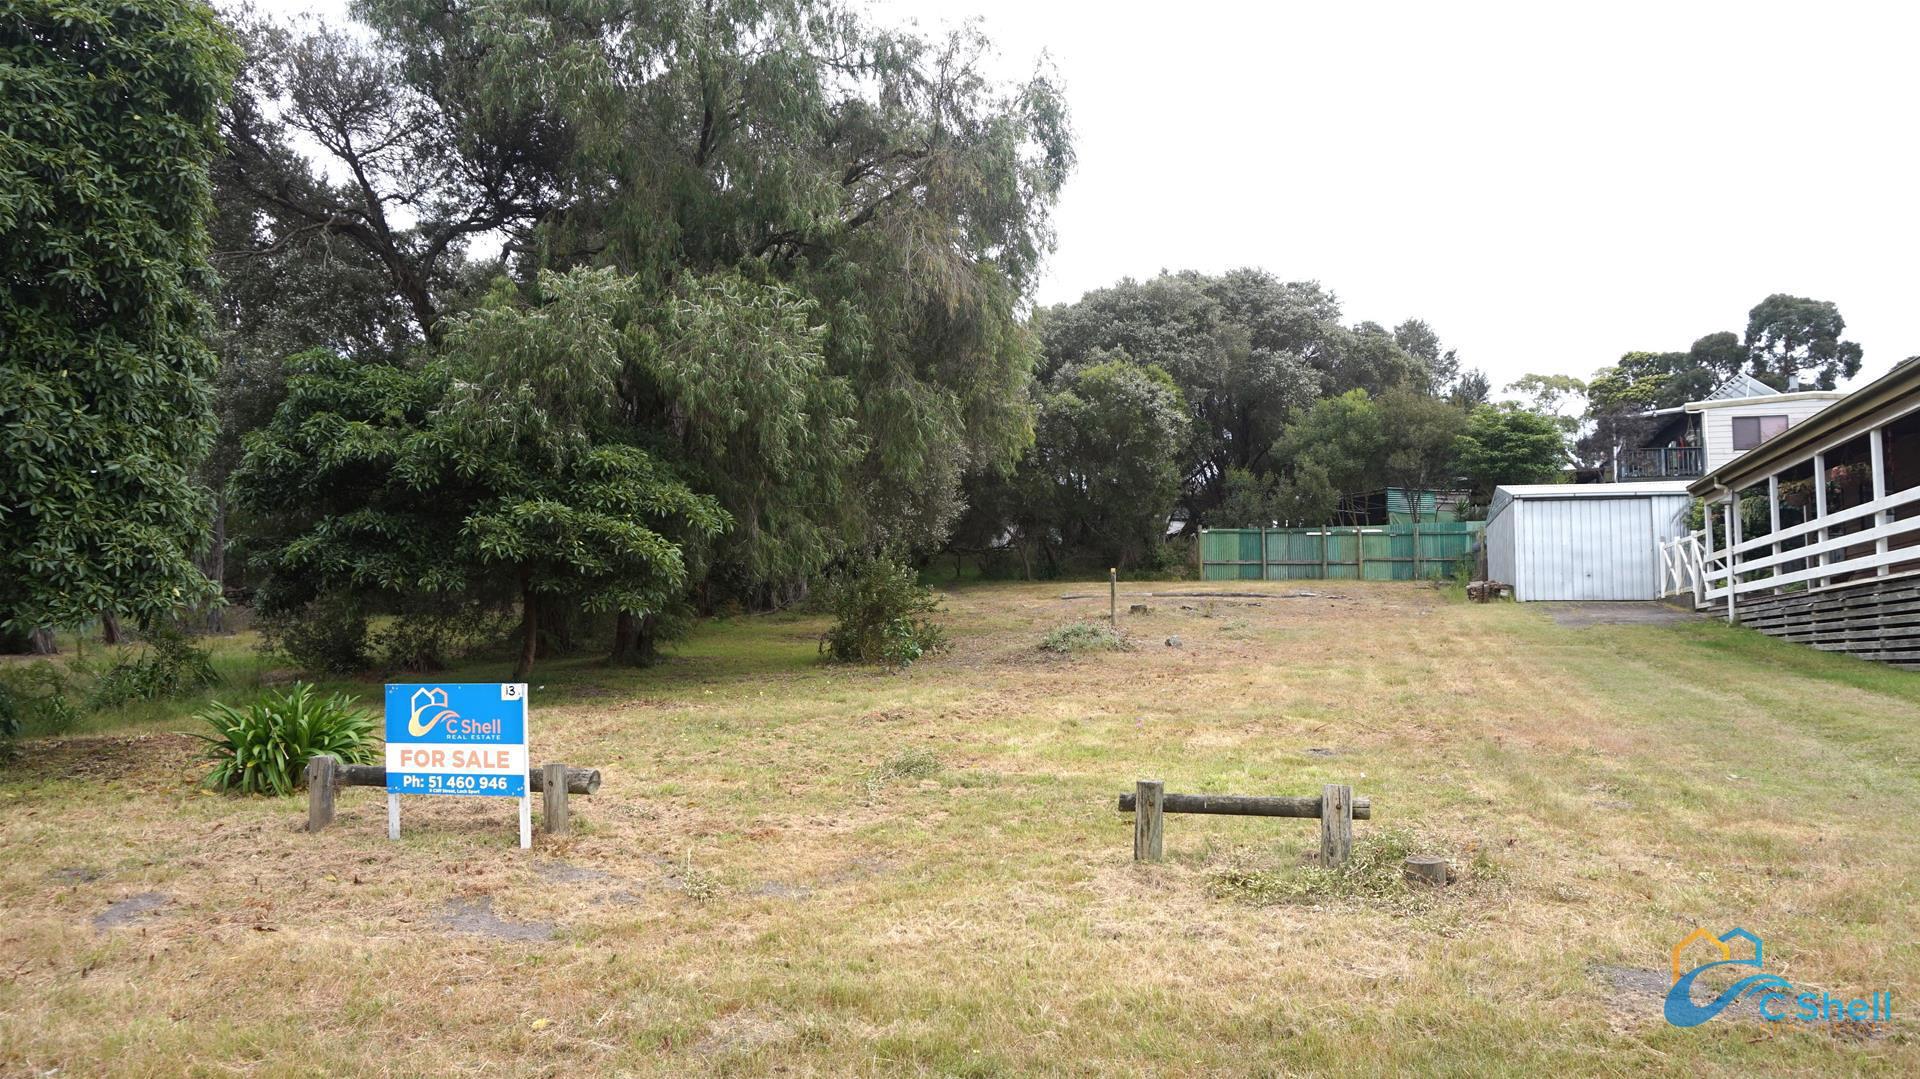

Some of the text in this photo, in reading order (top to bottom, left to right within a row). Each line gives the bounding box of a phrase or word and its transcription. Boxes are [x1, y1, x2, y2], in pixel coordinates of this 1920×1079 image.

[446, 719, 501, 734] C Shell
[400, 749, 510, 769] FOR SALE
[403, 775, 508, 790] Ph: 51 460 946
